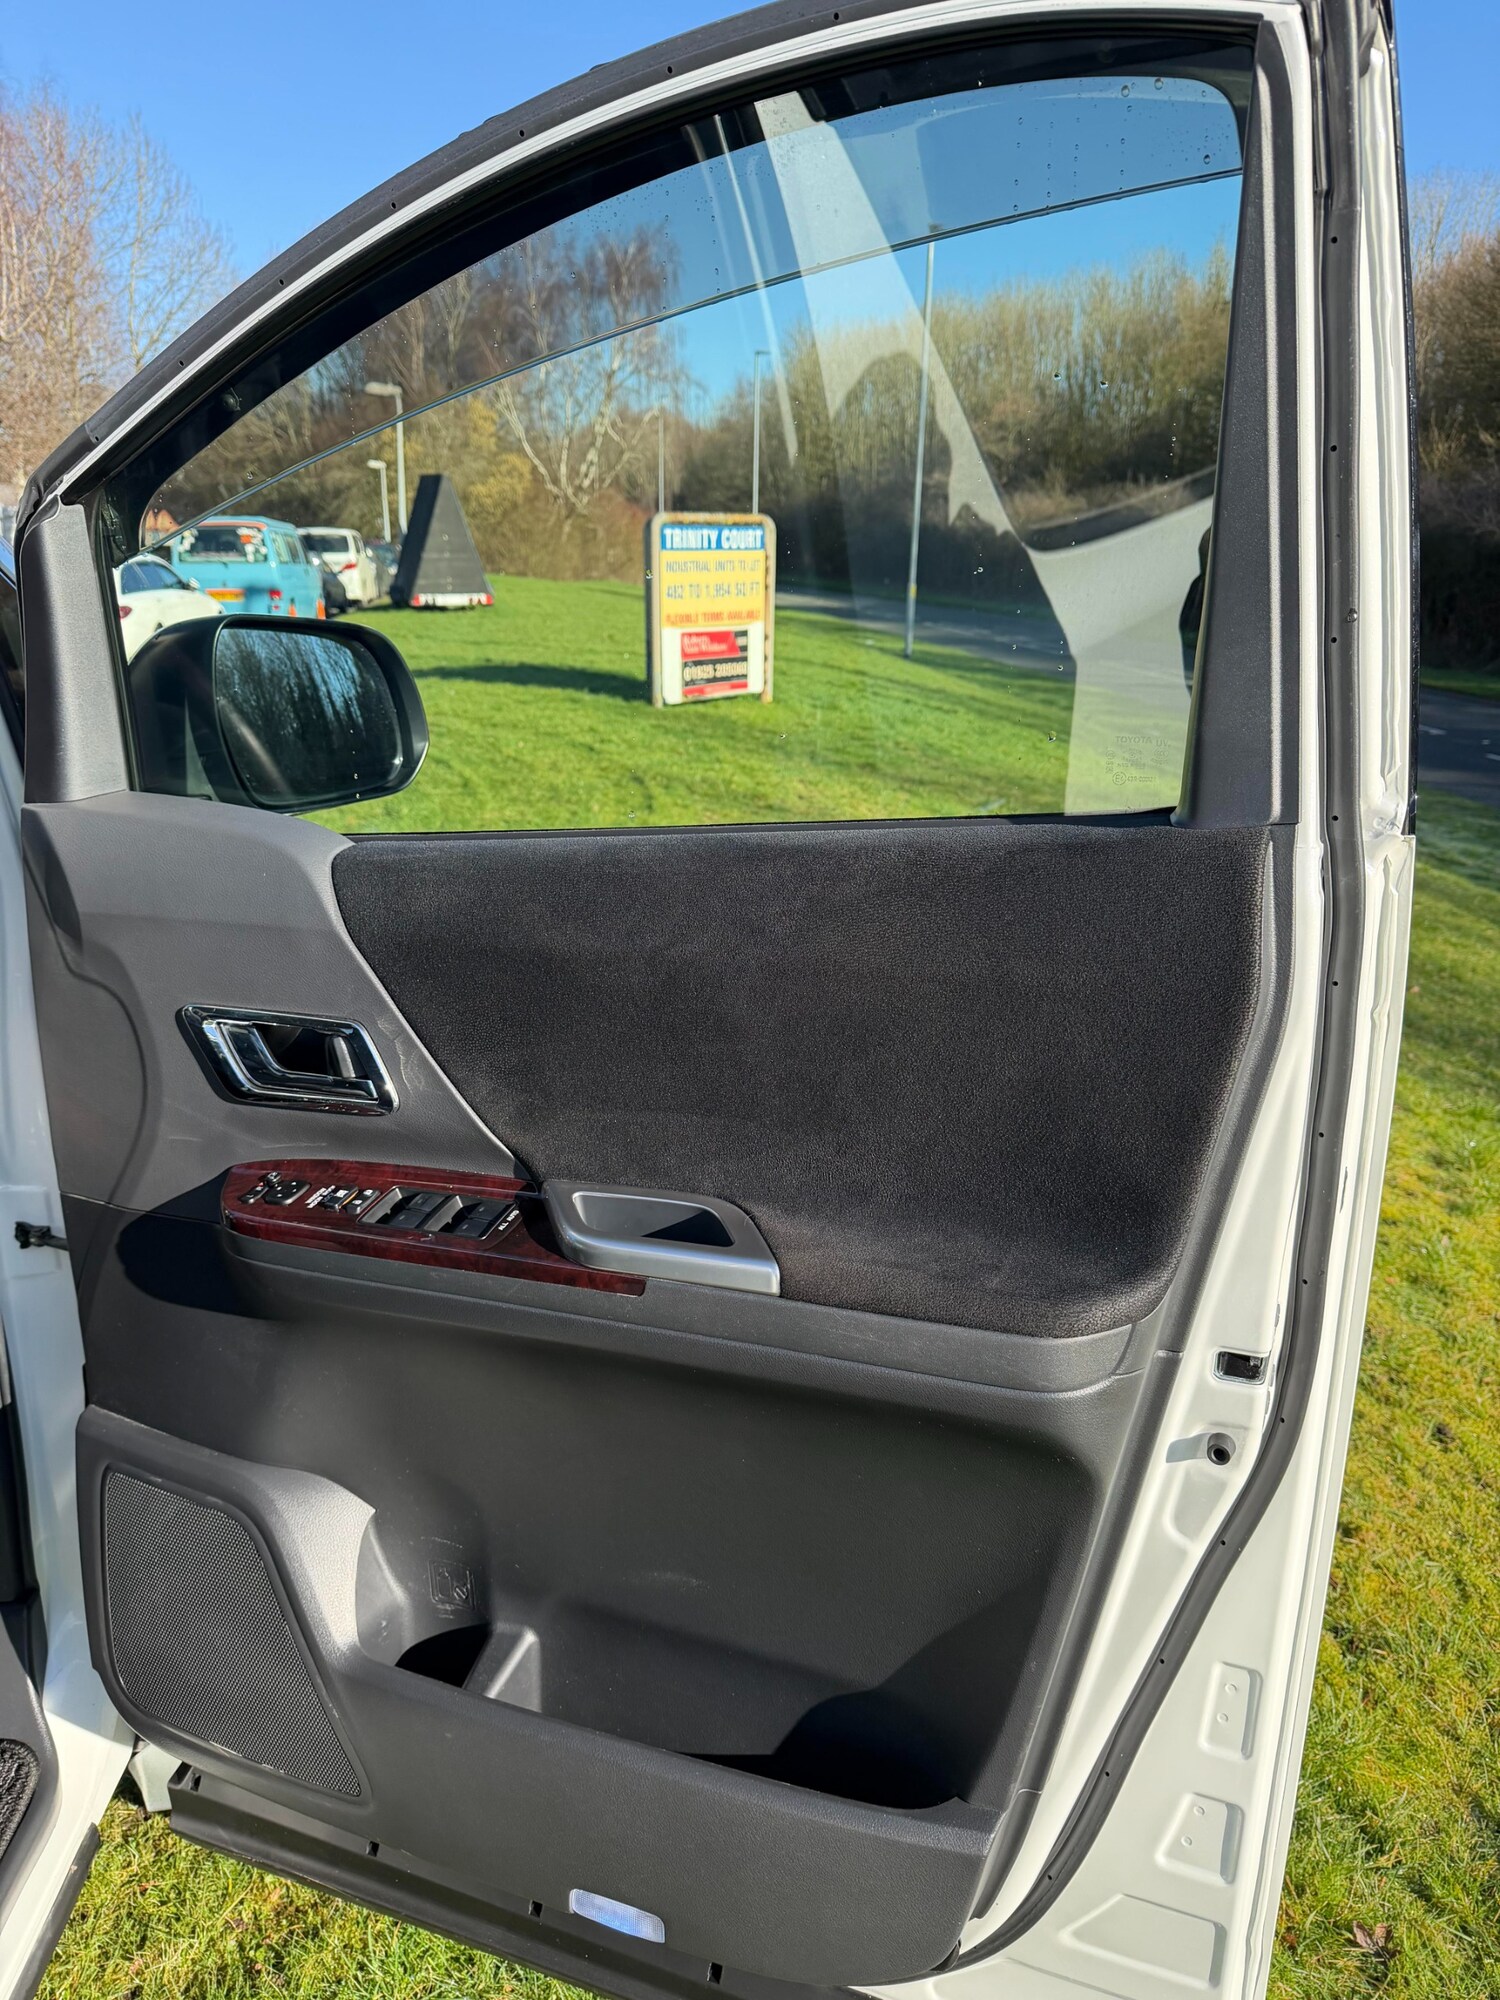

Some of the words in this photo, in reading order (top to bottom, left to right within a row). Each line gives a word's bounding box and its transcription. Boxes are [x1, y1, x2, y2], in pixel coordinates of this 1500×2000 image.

[664, 528, 718, 549] TRINITY
[721, 528, 763, 549] COURT
[1115, 735, 1153, 744] TOYOTA
